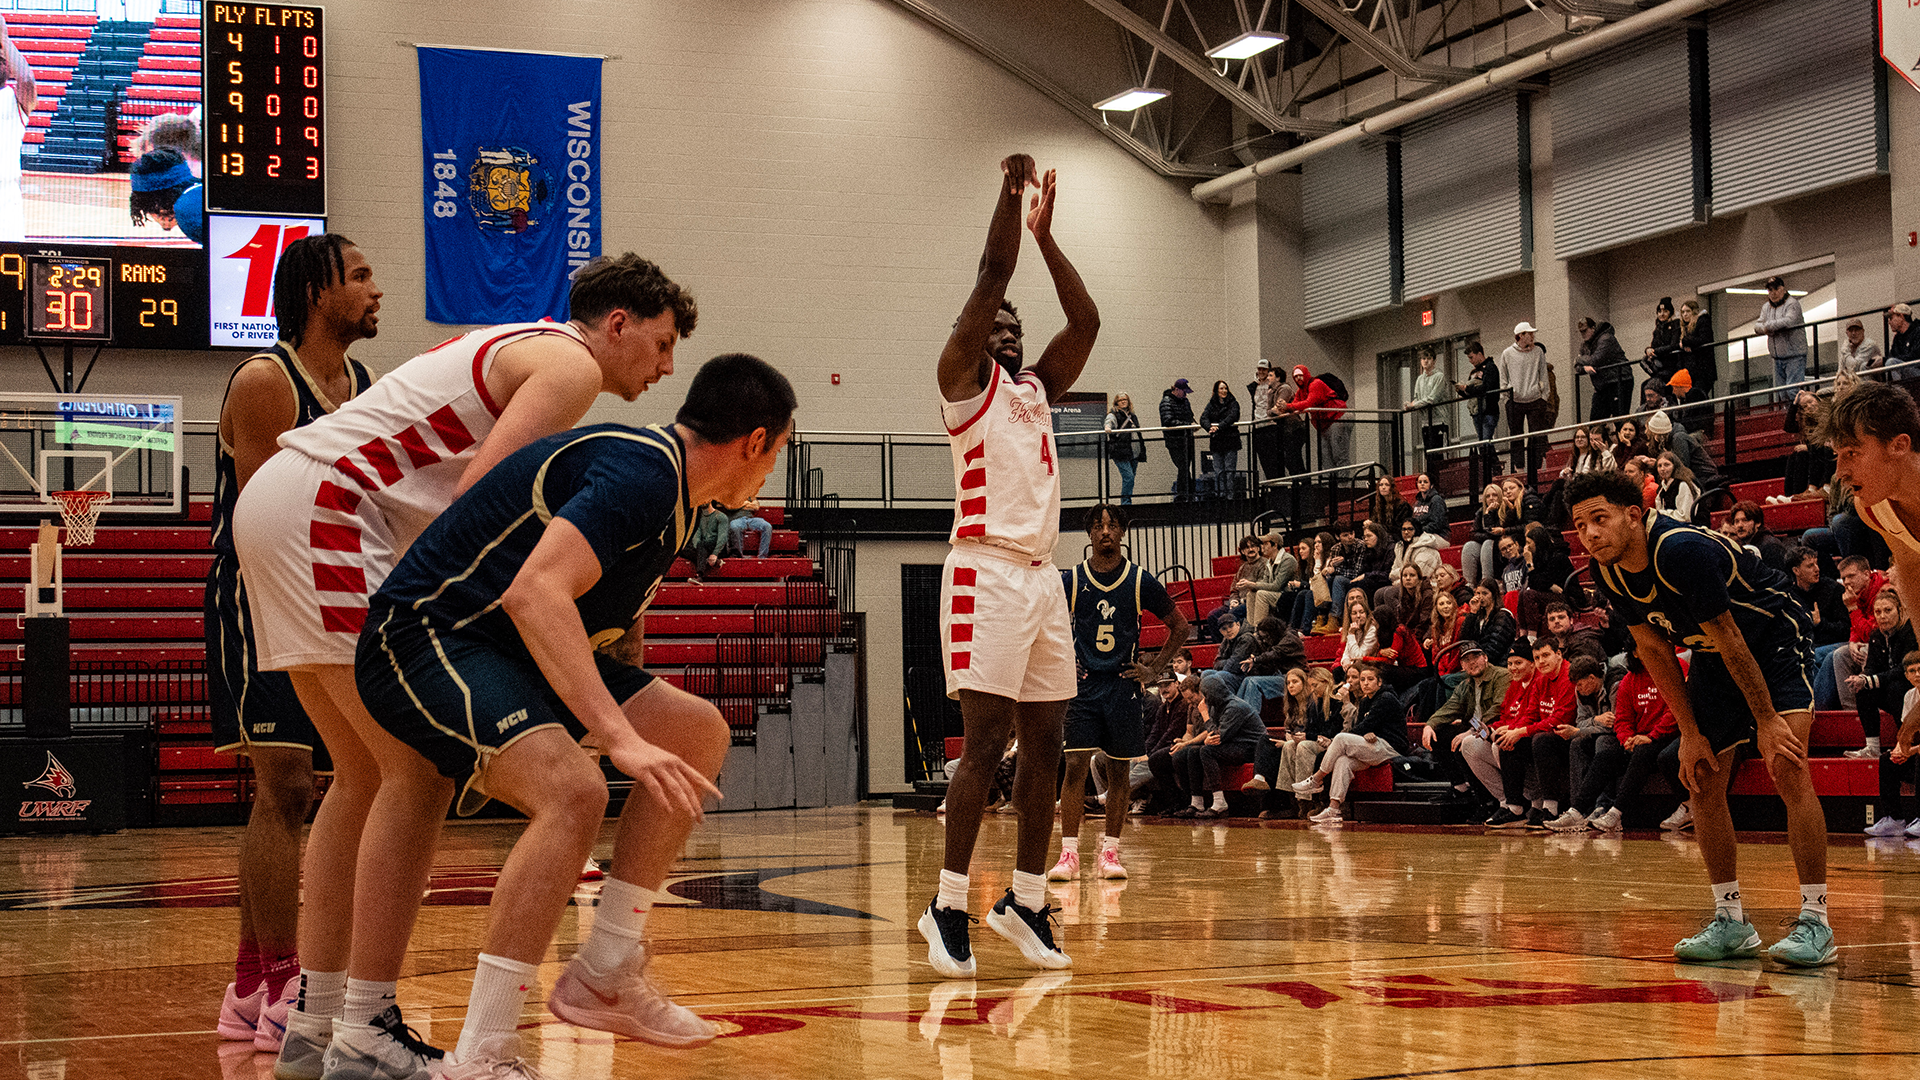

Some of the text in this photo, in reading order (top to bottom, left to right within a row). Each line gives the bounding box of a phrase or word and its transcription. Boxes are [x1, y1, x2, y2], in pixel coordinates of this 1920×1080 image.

[215, 5, 314, 28] PLY FL PTS
[228, 32, 317, 58] 4 1 0
[228, 61, 317, 88] 5 1 0
[229, 92, 318, 118] 9 0 0
[221, 123, 318, 147] 11 1 9
[221, 153, 318, 179] 13 2 3
[433, 149, 457, 218] 1848
[566, 101, 591, 280] WISCONSIN
[51, 265, 101, 288] 2:29
[121, 263, 166, 283] RAMS
[46, 290, 92, 330] 30
[139, 298, 178, 327] 29
[214, 322, 239, 330] FIRST
[232, 331, 246, 339] OF
[1040, 431, 1054, 476] 4
[1096, 624, 1115, 652] 5
[253, 722, 276, 734] NCU
[496, 708, 528, 734] NCU
